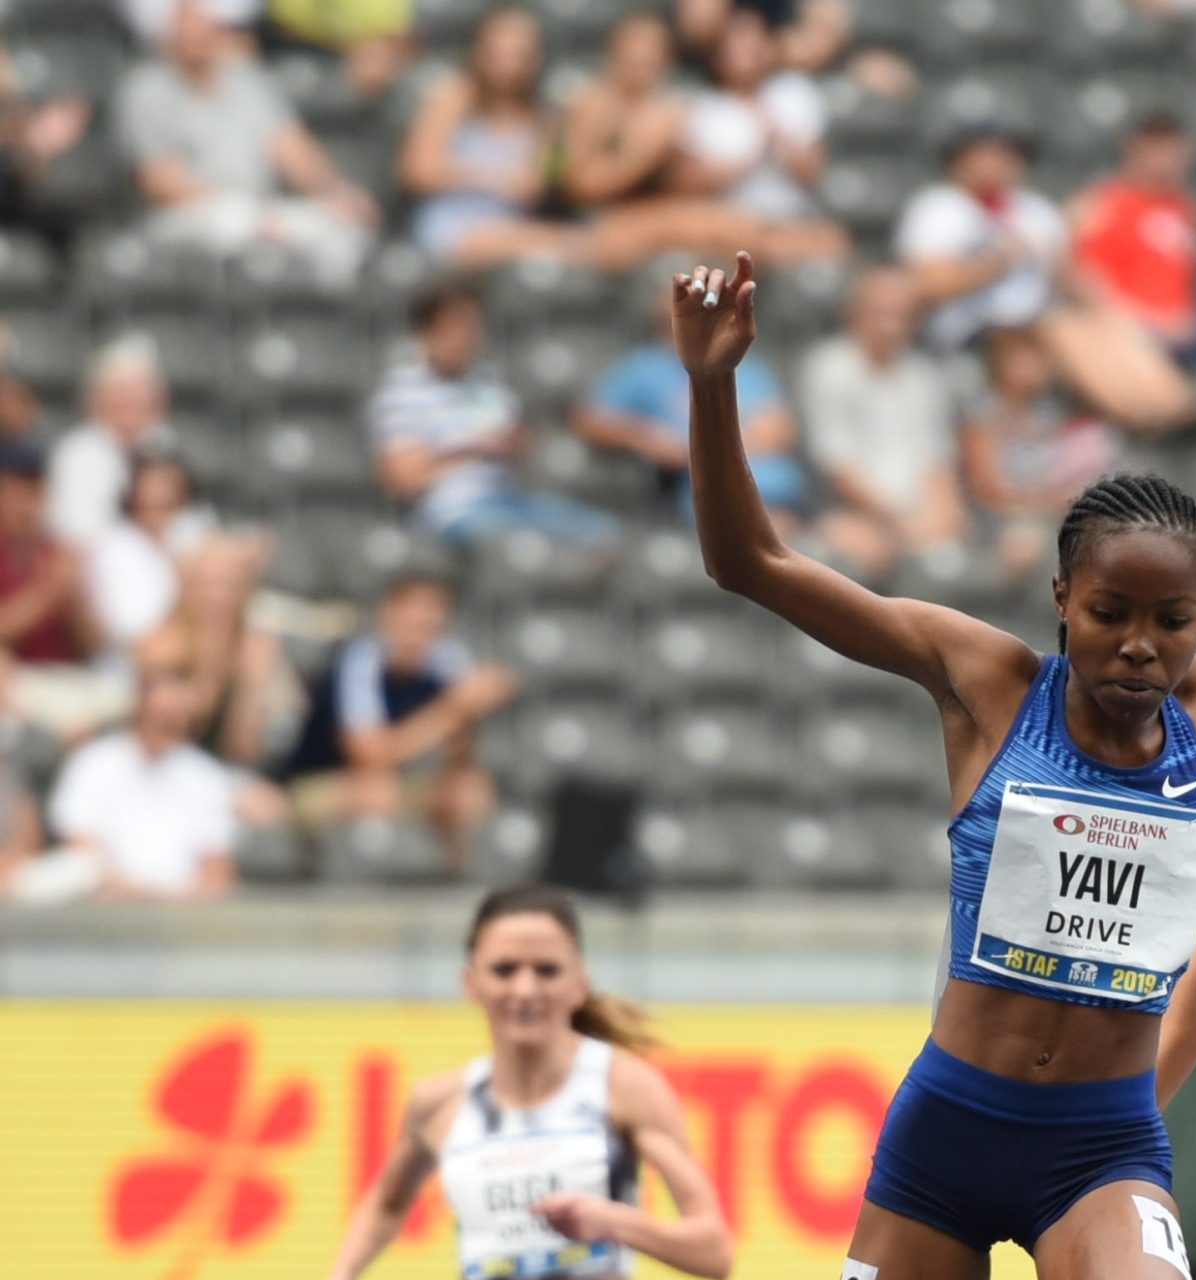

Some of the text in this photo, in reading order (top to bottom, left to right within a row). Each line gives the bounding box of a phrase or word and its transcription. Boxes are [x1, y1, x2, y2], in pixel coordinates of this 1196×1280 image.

[1087, 830, 1139, 850] BERLIN
[1088, 814, 1168, 841] SPIELBANK
[1059, 851, 1146, 909] YAVI
[1045, 911, 1134, 946] DRIVE
[1005, 947, 1059, 977] ISTAF
[1110, 968, 1157, 994] 2019
